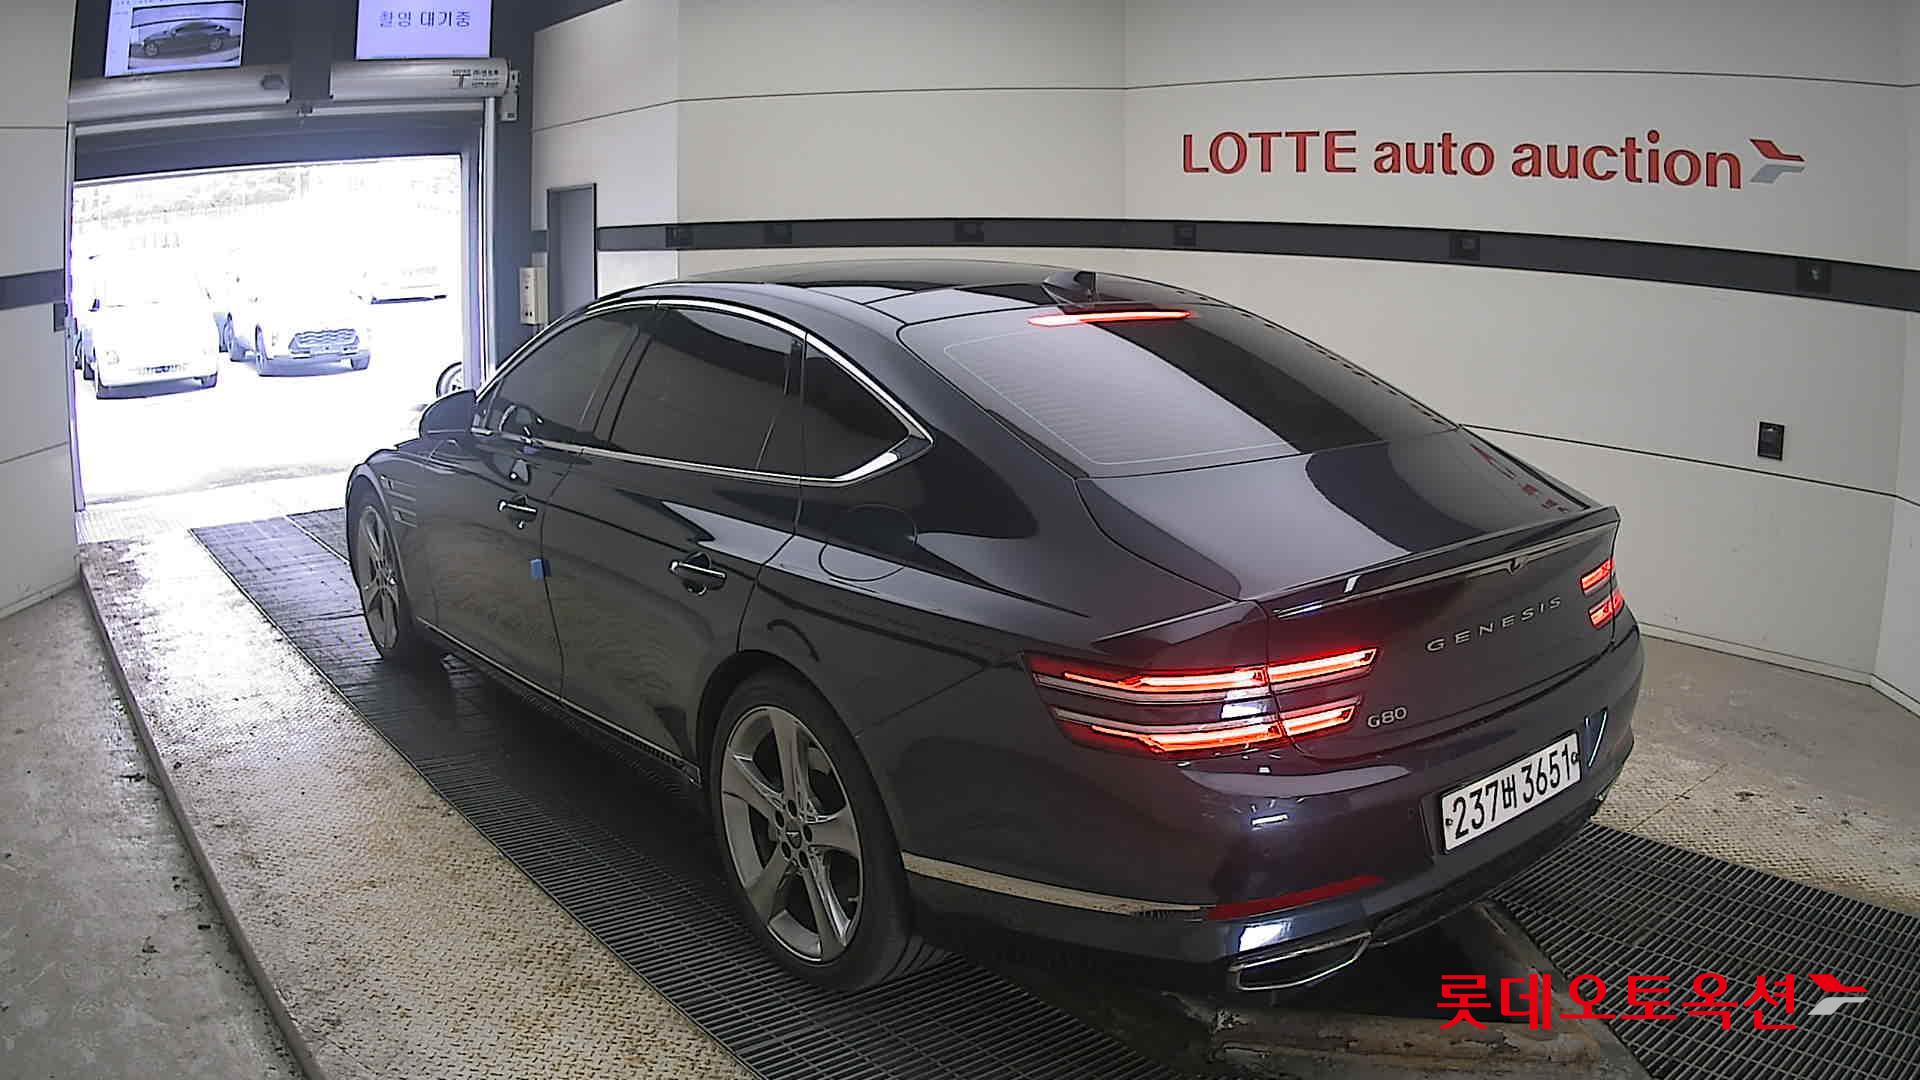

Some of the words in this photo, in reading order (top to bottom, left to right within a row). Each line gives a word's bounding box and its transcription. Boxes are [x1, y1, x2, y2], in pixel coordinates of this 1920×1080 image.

[420, 10, 471, 27] 대기중
[1183, 130, 1357, 174] LOTTE
[1374, 132, 1496, 177] auto
[1512, 130, 1742, 189] auction
[1426, 596, 1562, 652] GENESIS
[1367, 706, 1408, 728] G80
[1521, 744, 1571, 803] 3651
